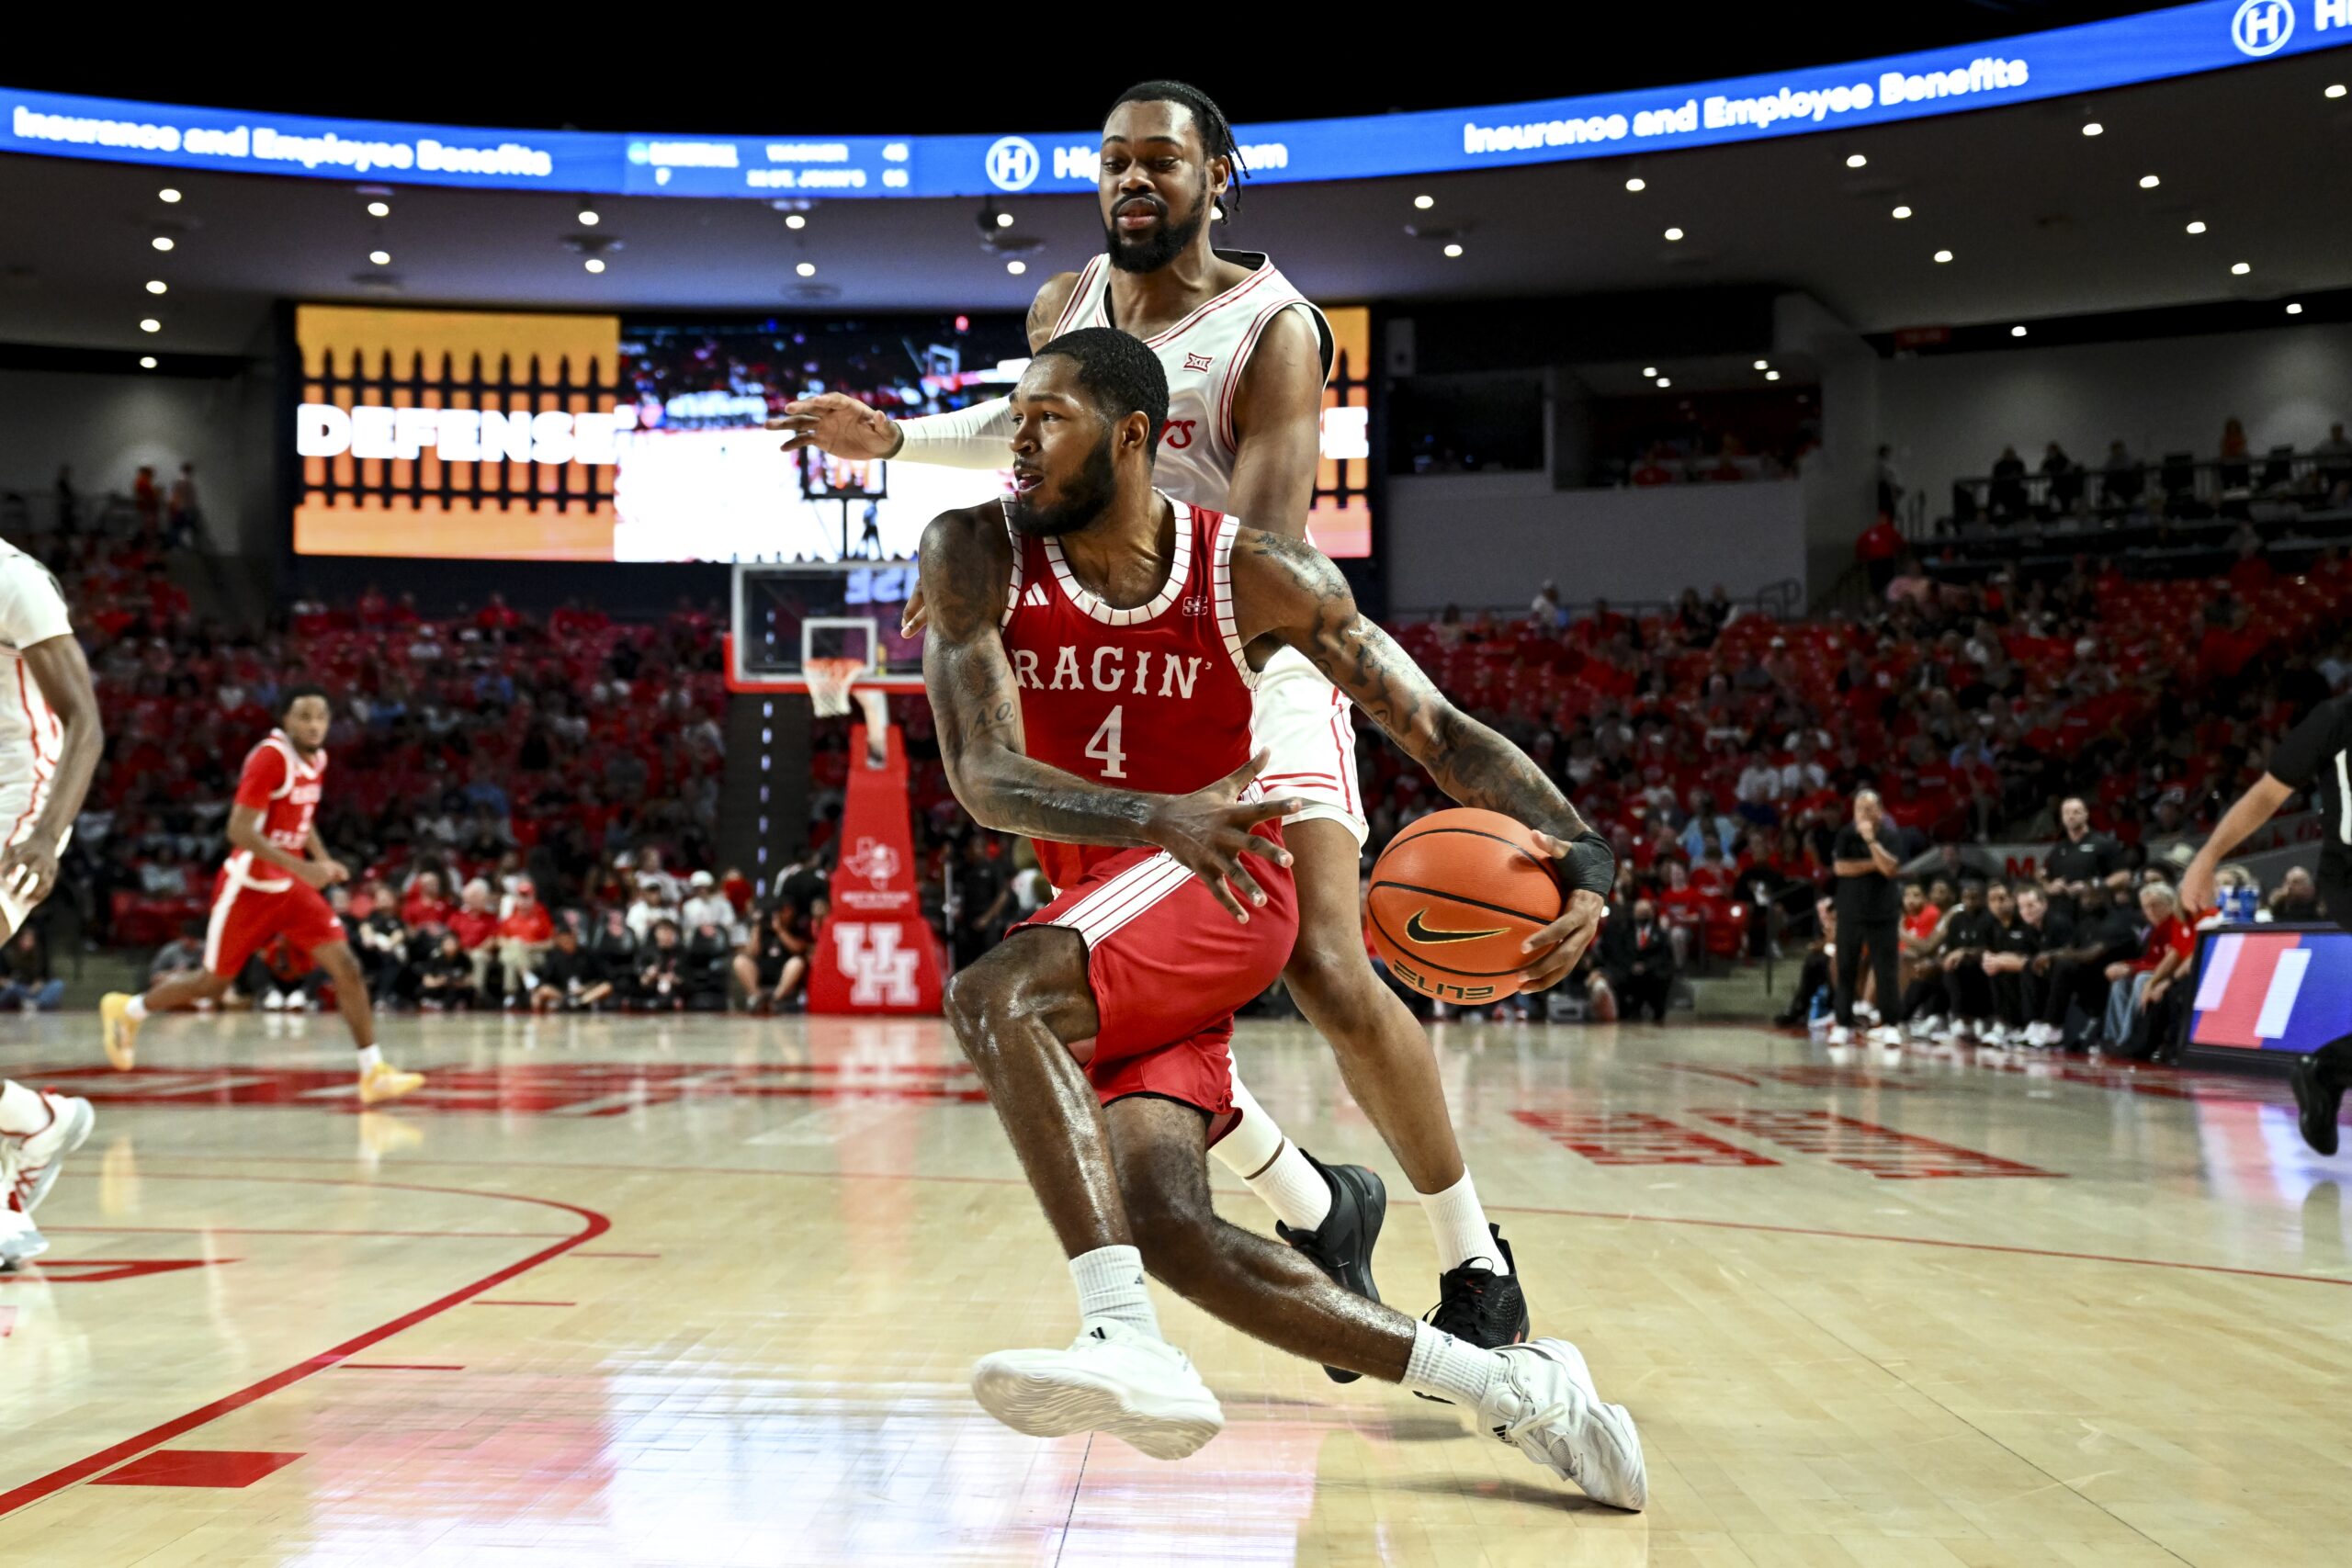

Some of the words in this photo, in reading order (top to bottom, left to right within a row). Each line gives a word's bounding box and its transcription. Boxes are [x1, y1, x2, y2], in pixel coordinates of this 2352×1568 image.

[1464, 114, 1629, 154] Insurance
[1632, 98, 1699, 137] and
[1703, 83, 1874, 130] Employee
[1879, 57, 2030, 106] Benefits
[13, 106, 182, 152] Insurance
[183, 126, 250, 157] and
[252, 127, 414, 173] Employee
[416, 139, 552, 176] Benefits
[297, 403, 618, 465] DEFENSE
[1011, 645, 1213, 699] RAGIN'
[1085, 705, 1127, 779] 4
[832, 921, 921, 1007] UH
[1393, 959, 1496, 1000] ELITE
